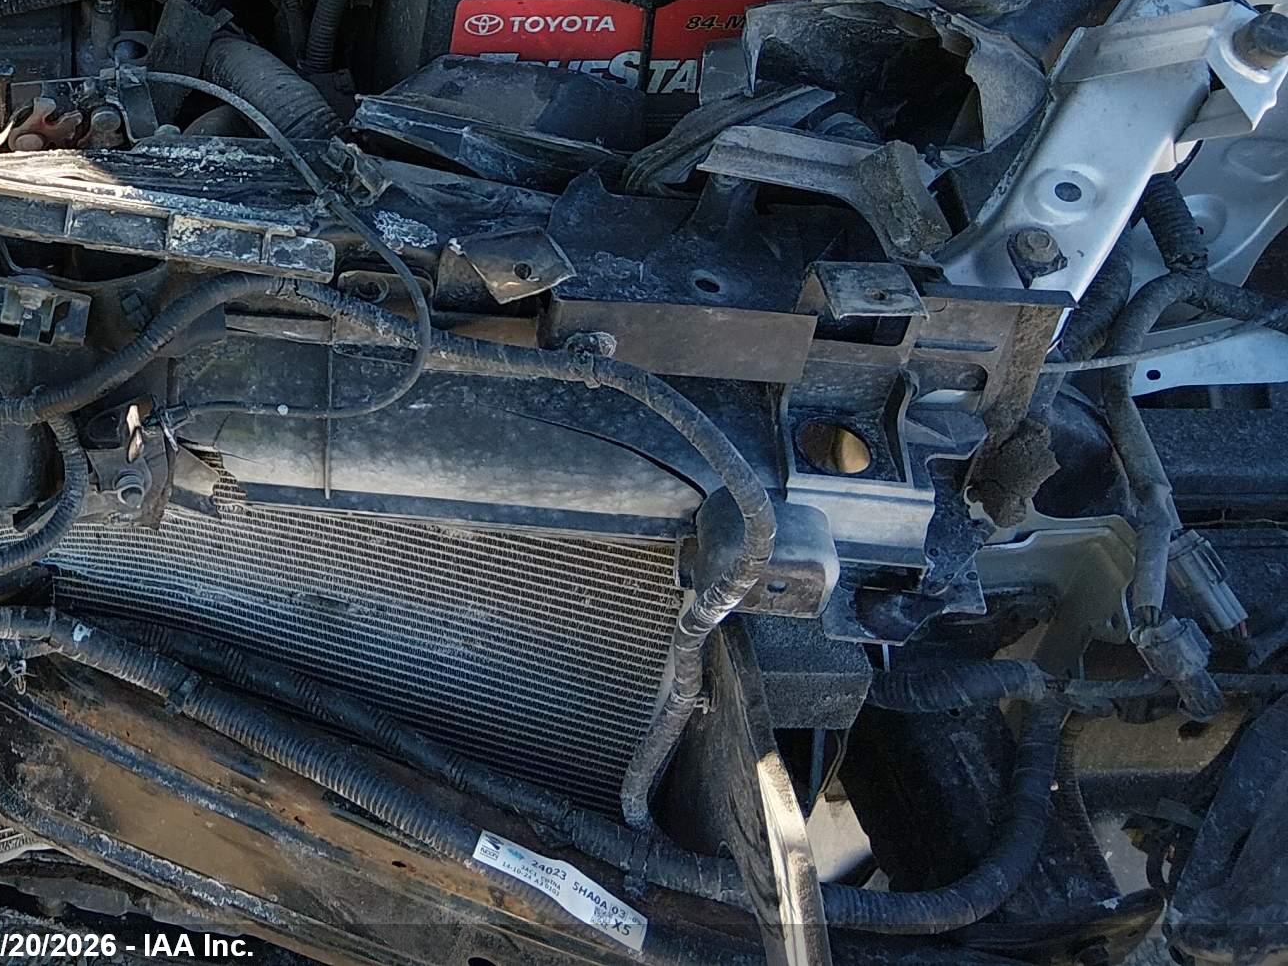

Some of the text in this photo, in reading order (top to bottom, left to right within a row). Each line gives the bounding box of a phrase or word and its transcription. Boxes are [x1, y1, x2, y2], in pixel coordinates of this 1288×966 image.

[509, 15, 616, 33] TOYOTA
[531, 859, 568, 881] 24023
[612, 918, 632, 936] X5
